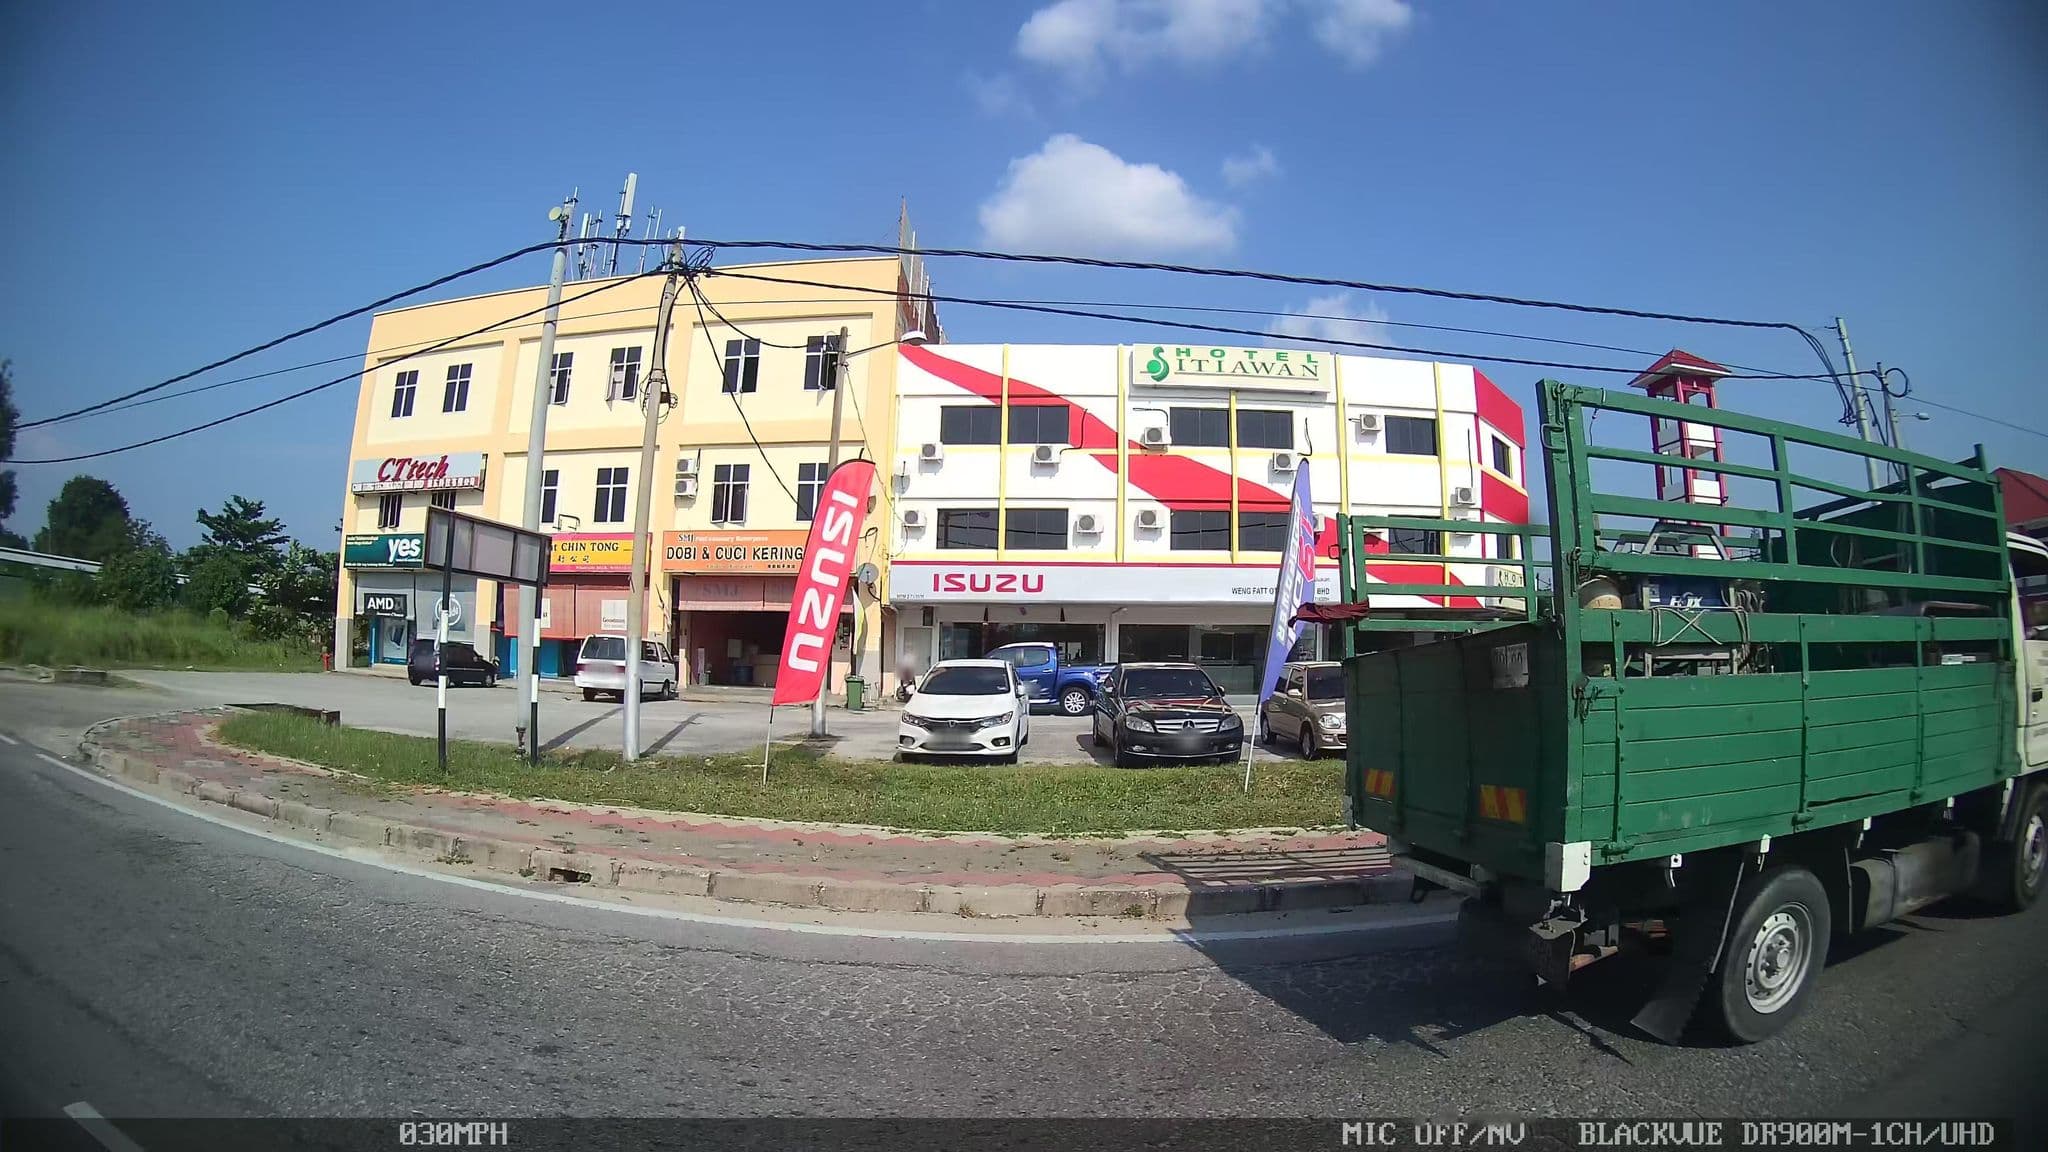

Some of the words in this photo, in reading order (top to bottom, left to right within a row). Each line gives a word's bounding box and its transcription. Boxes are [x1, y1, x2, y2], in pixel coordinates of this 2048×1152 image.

[1176, 347, 1318, 364] HOTEL
[388, 538, 421, 562] yes
[561, 542, 587, 552] CHIN
[590, 542, 619, 552] TONG
[666, 546, 697, 561] DOBI
[702, 546, 710, 560] &
[715, 546, 747, 561] CUCI
[752, 546, 803, 561] KERING
[787, 489, 859, 673] ISUZU
[933, 573, 1044, 593] ISUZU
[1231, 587, 1252, 595] WENG
[1252, 587, 1268, 595] FATT
[367, 597, 394, 610] AMD
